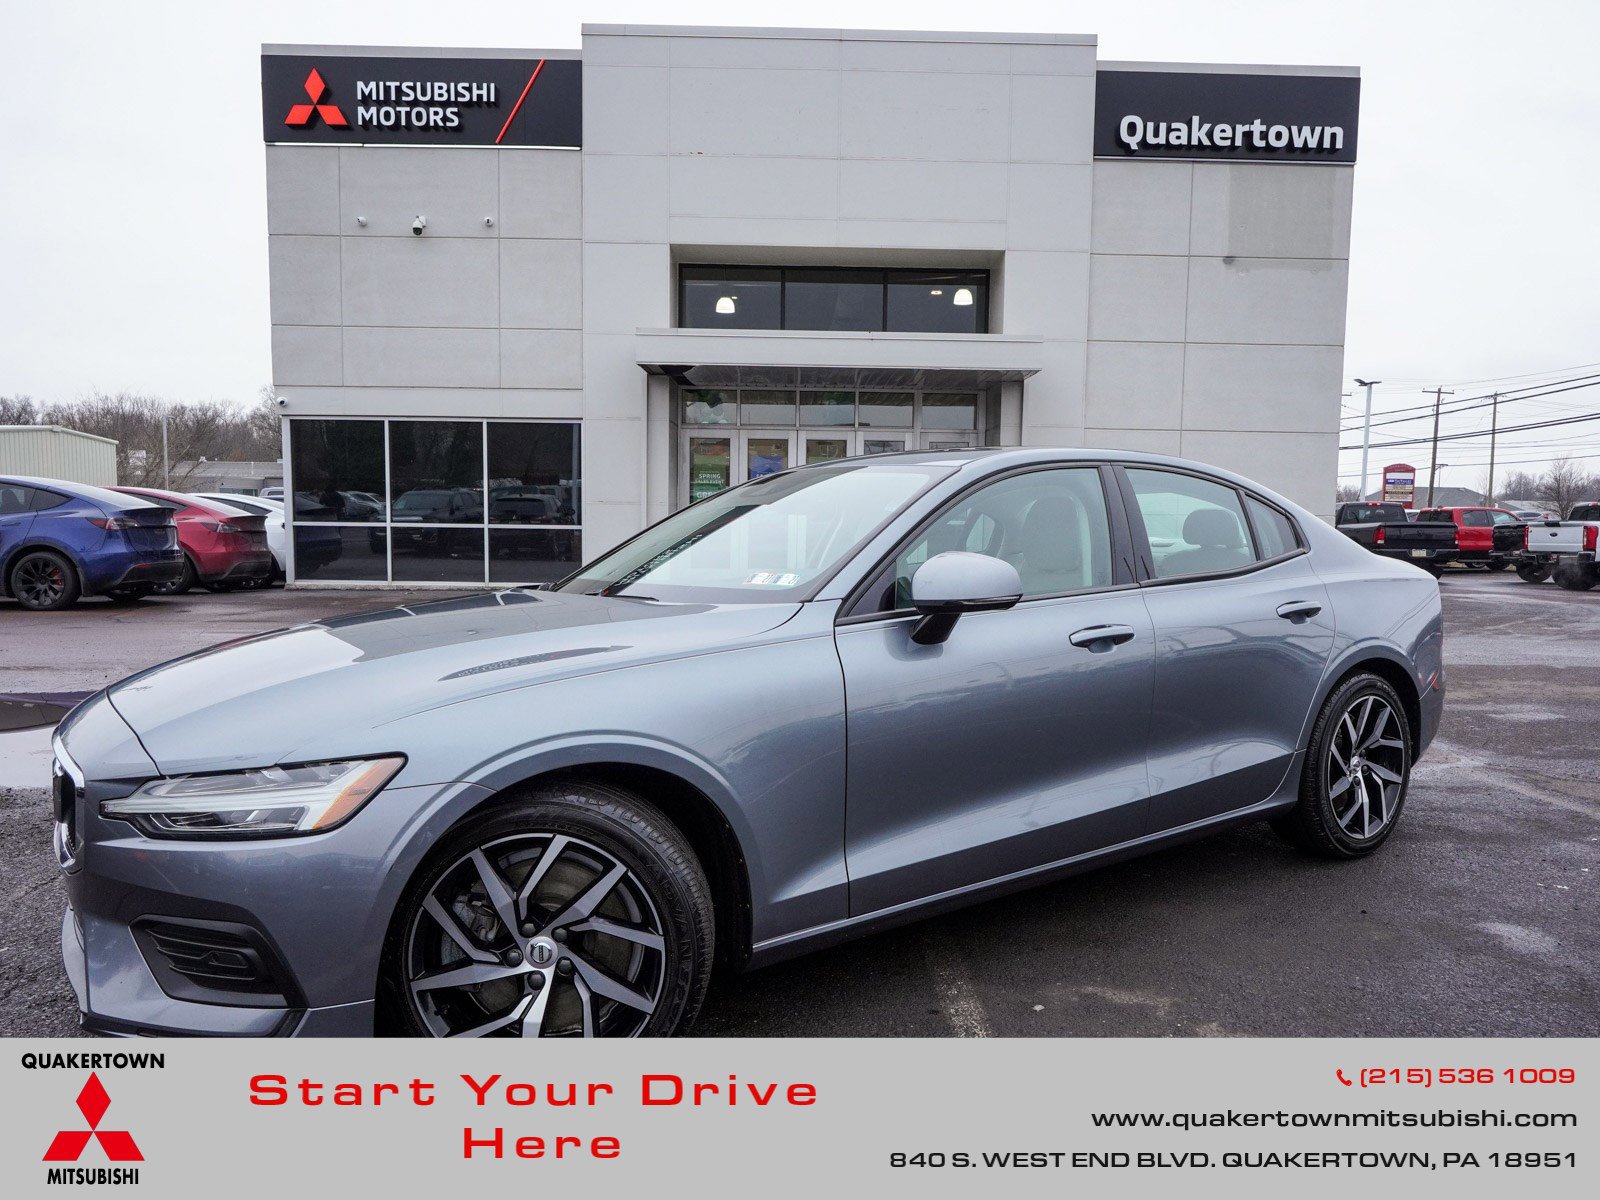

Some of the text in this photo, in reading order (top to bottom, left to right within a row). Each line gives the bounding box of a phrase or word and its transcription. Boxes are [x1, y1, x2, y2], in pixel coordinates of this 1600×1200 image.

[356, 81, 496, 103] MITSUBISHI
[356, 106, 460, 127] MOTORS
[1119, 115, 1344, 150] Quakertown
